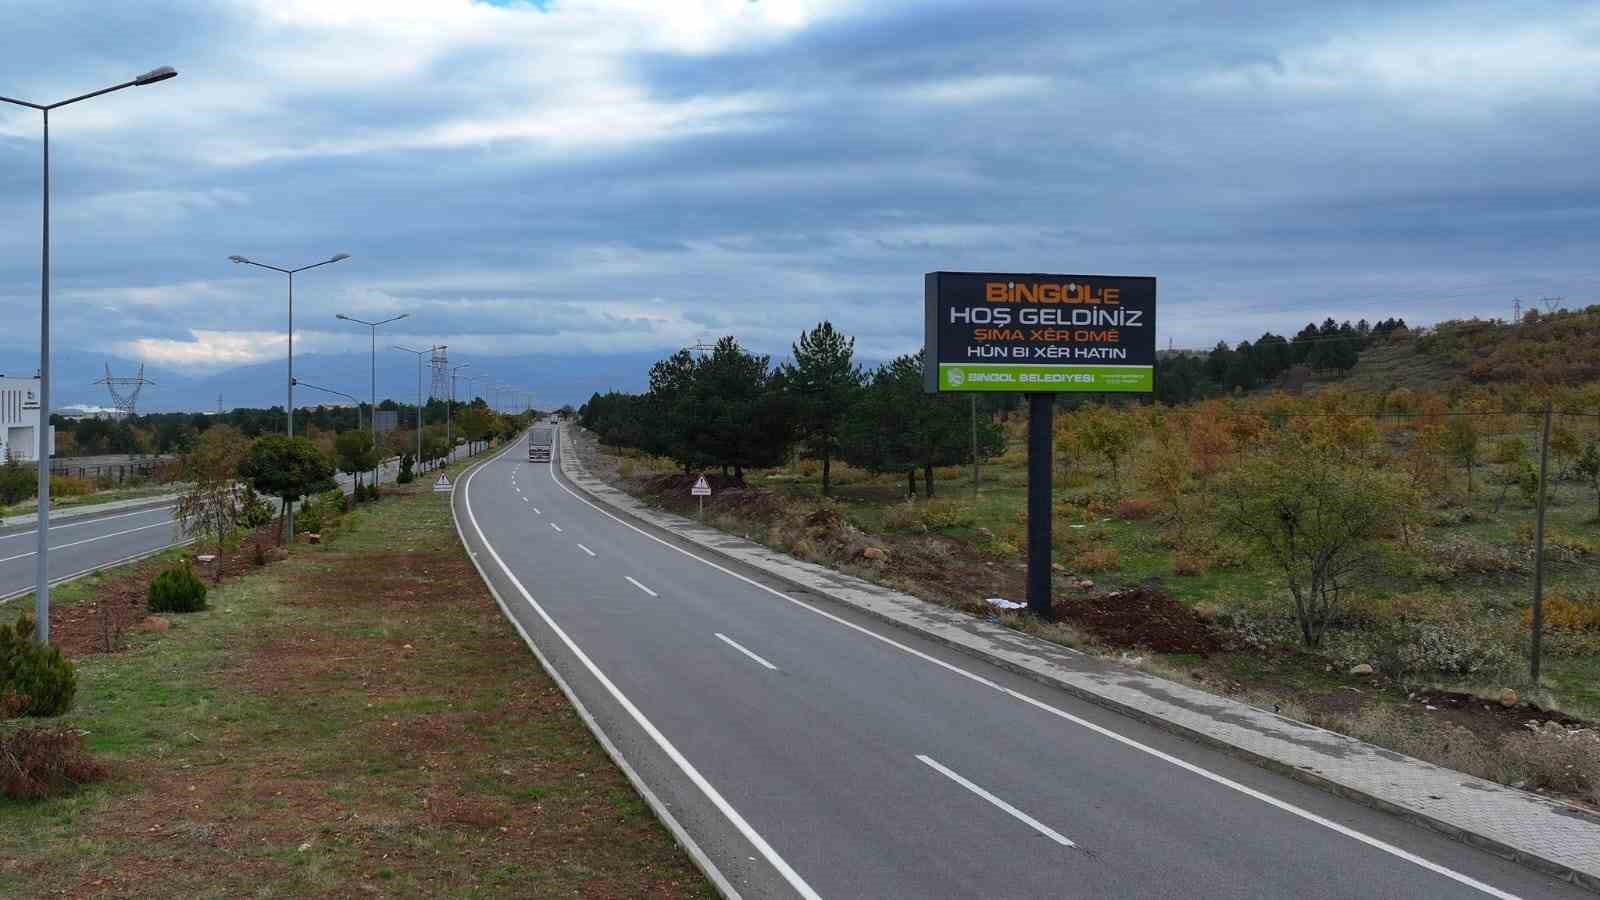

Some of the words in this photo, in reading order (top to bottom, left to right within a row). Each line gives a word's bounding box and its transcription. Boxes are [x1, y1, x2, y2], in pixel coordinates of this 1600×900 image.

[950, 306, 1011, 328] HOŞ
[1019, 306, 1143, 327] GELDİNİZ
[1012, 347, 1030, 358] BI
[1075, 348, 1127, 360] HATIN
